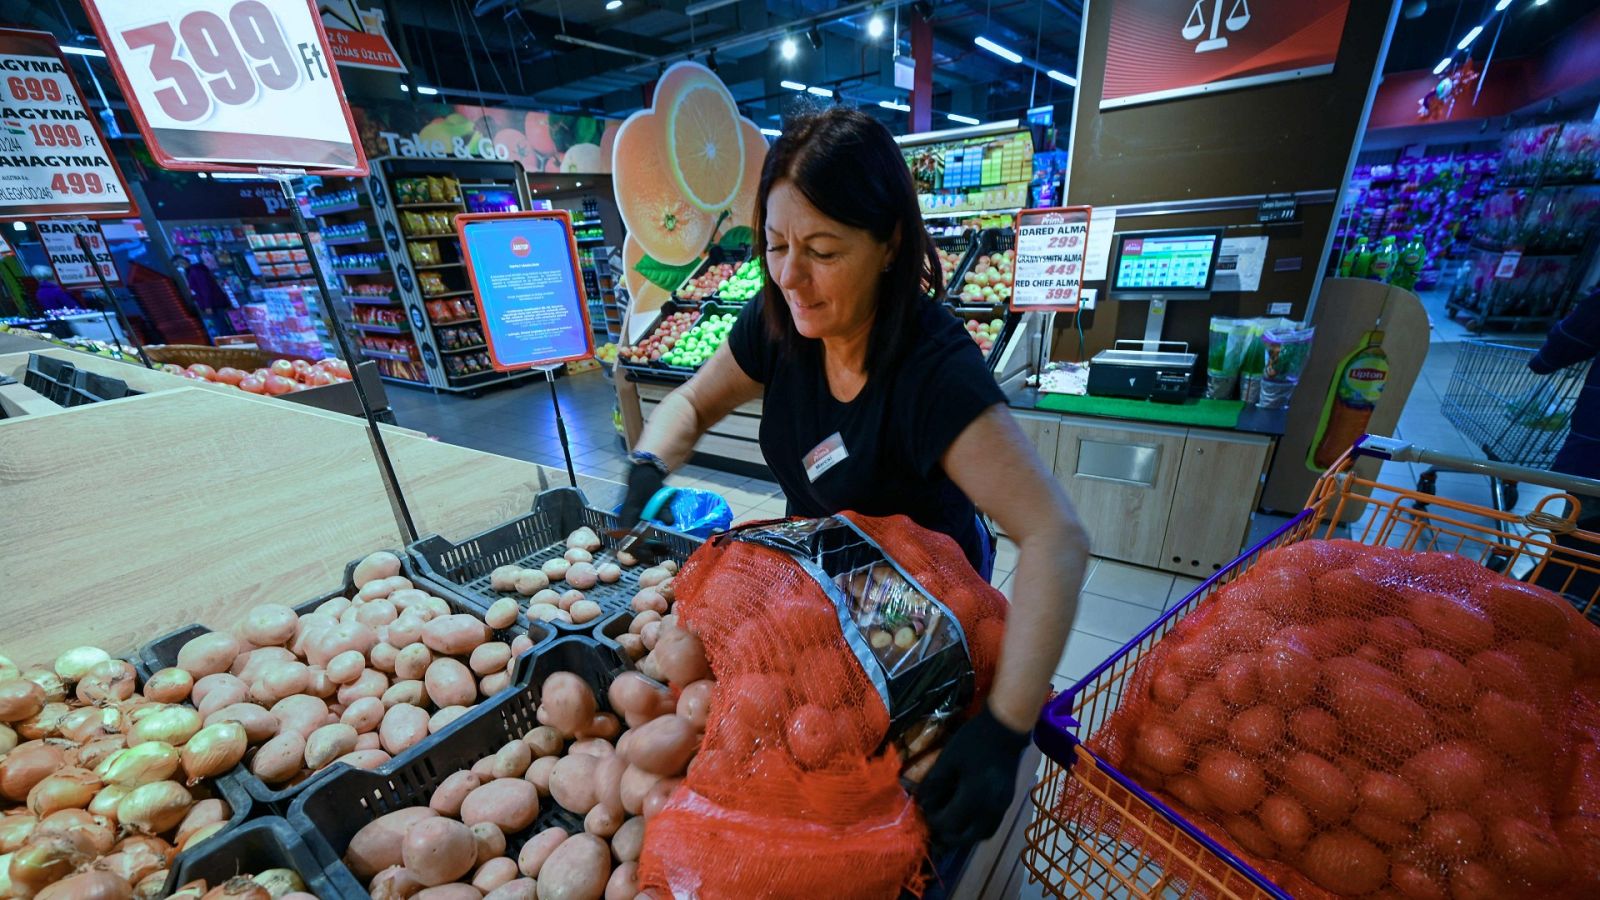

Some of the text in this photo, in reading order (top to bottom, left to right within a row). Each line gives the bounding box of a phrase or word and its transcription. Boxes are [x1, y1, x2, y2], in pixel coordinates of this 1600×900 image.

[121, 0, 328, 122] 399 Ft
[7, 77, 61, 101] 699
[66, 94, 78, 105] Ft
[28, 124, 96, 147] 1999 Ft
[379, 131, 509, 160] Take & Go
[51, 172, 118, 194] 499 Ft
[1019, 225, 1087, 236] IDARED ALMA
[1047, 236, 1079, 248] 299
[52, 253, 111, 264] ANANSZ
[1017, 254, 1082, 263] GRANNYSMITH ALMA
[1045, 263, 1076, 275] 449
[1032, 279, 1055, 287] CHIEF
[1056, 279, 1079, 287] ALMA
[1045, 289, 1073, 299] 399
[1352, 370, 1384, 380] Lipton
